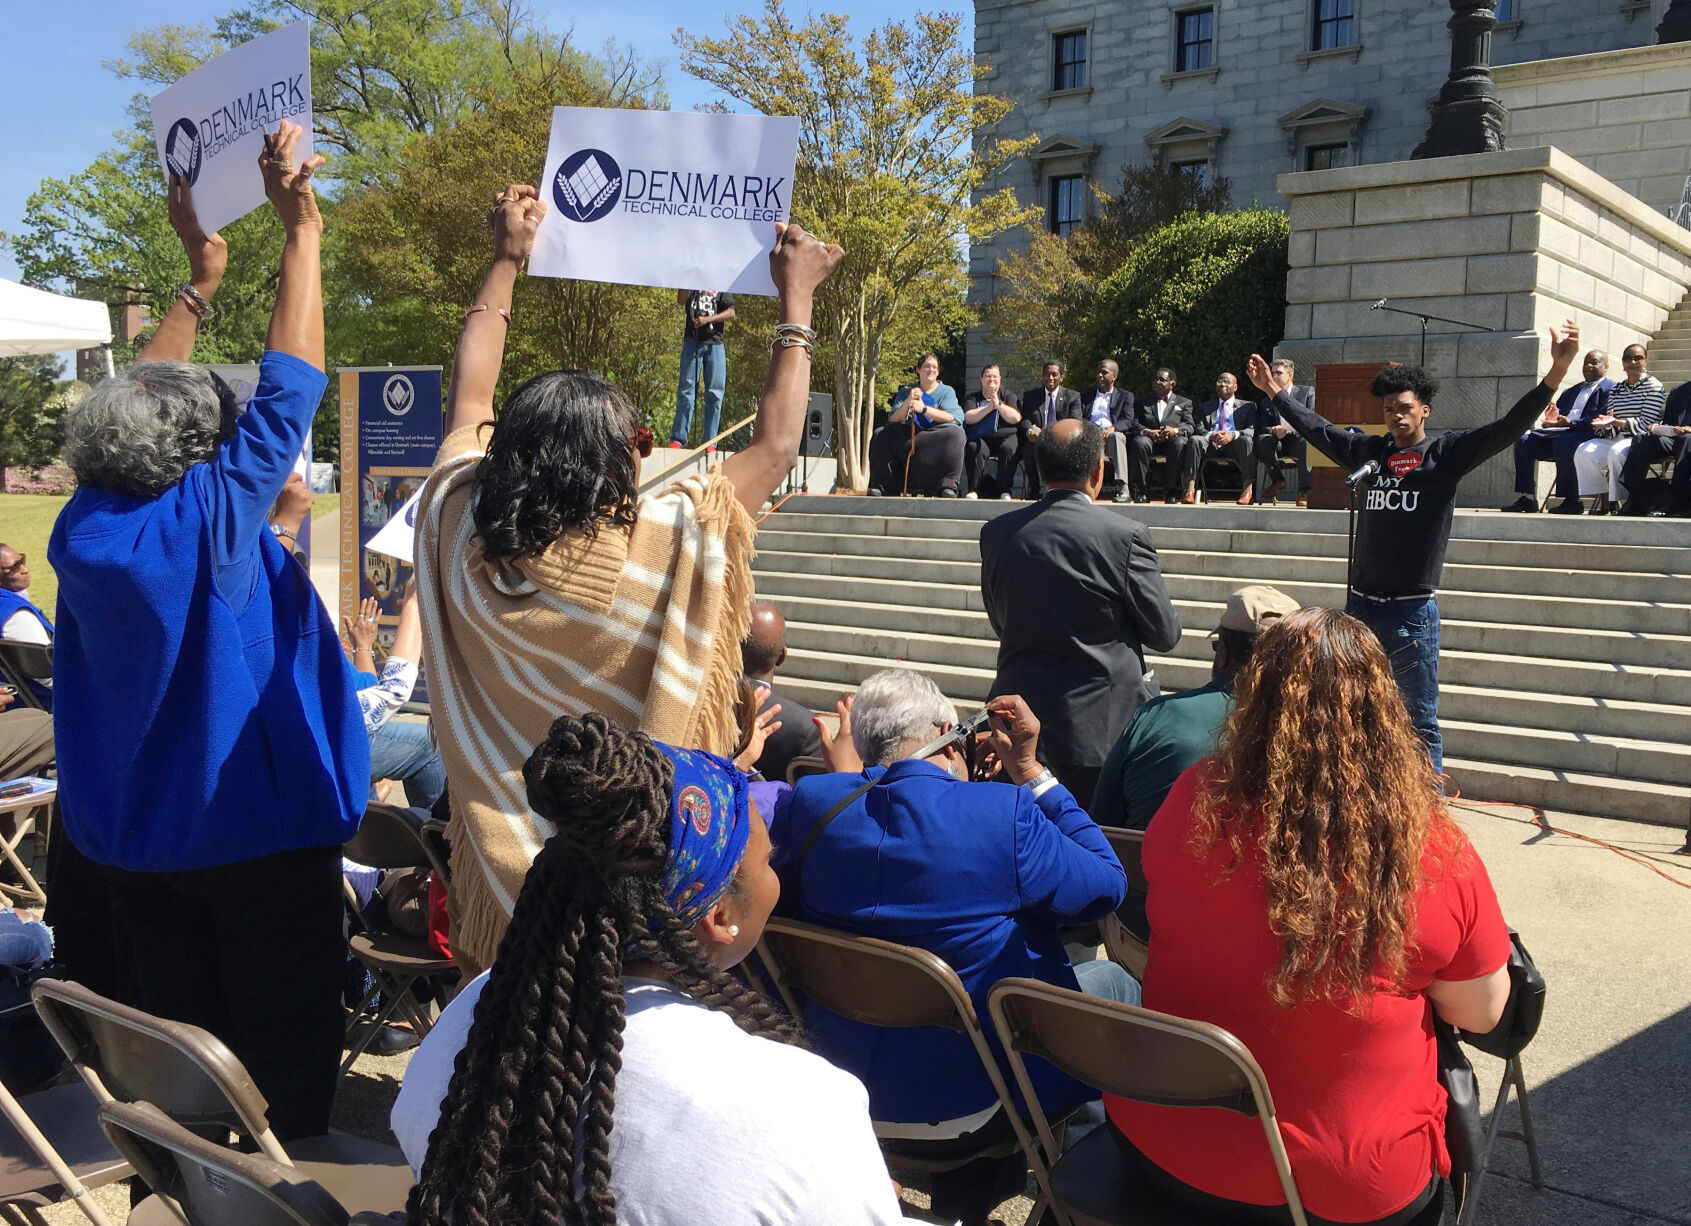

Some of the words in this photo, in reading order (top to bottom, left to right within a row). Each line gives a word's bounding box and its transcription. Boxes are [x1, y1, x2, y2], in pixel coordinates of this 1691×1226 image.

[200, 73, 304, 149] DENMARK
[203, 127, 250, 160] TECHNICAL
[250, 102, 307, 131] COLLEGE
[622, 200, 707, 218] TECHNICAL
[711, 206, 784, 222] COLLEGE
[624, 169, 786, 209] DENMARK
[342, 398, 354, 474] COLLEGE
[1366, 489, 1420, 512] HBCU
[1373, 475, 1404, 488] MY
[341, 479, 353, 576] TECHNICAL
